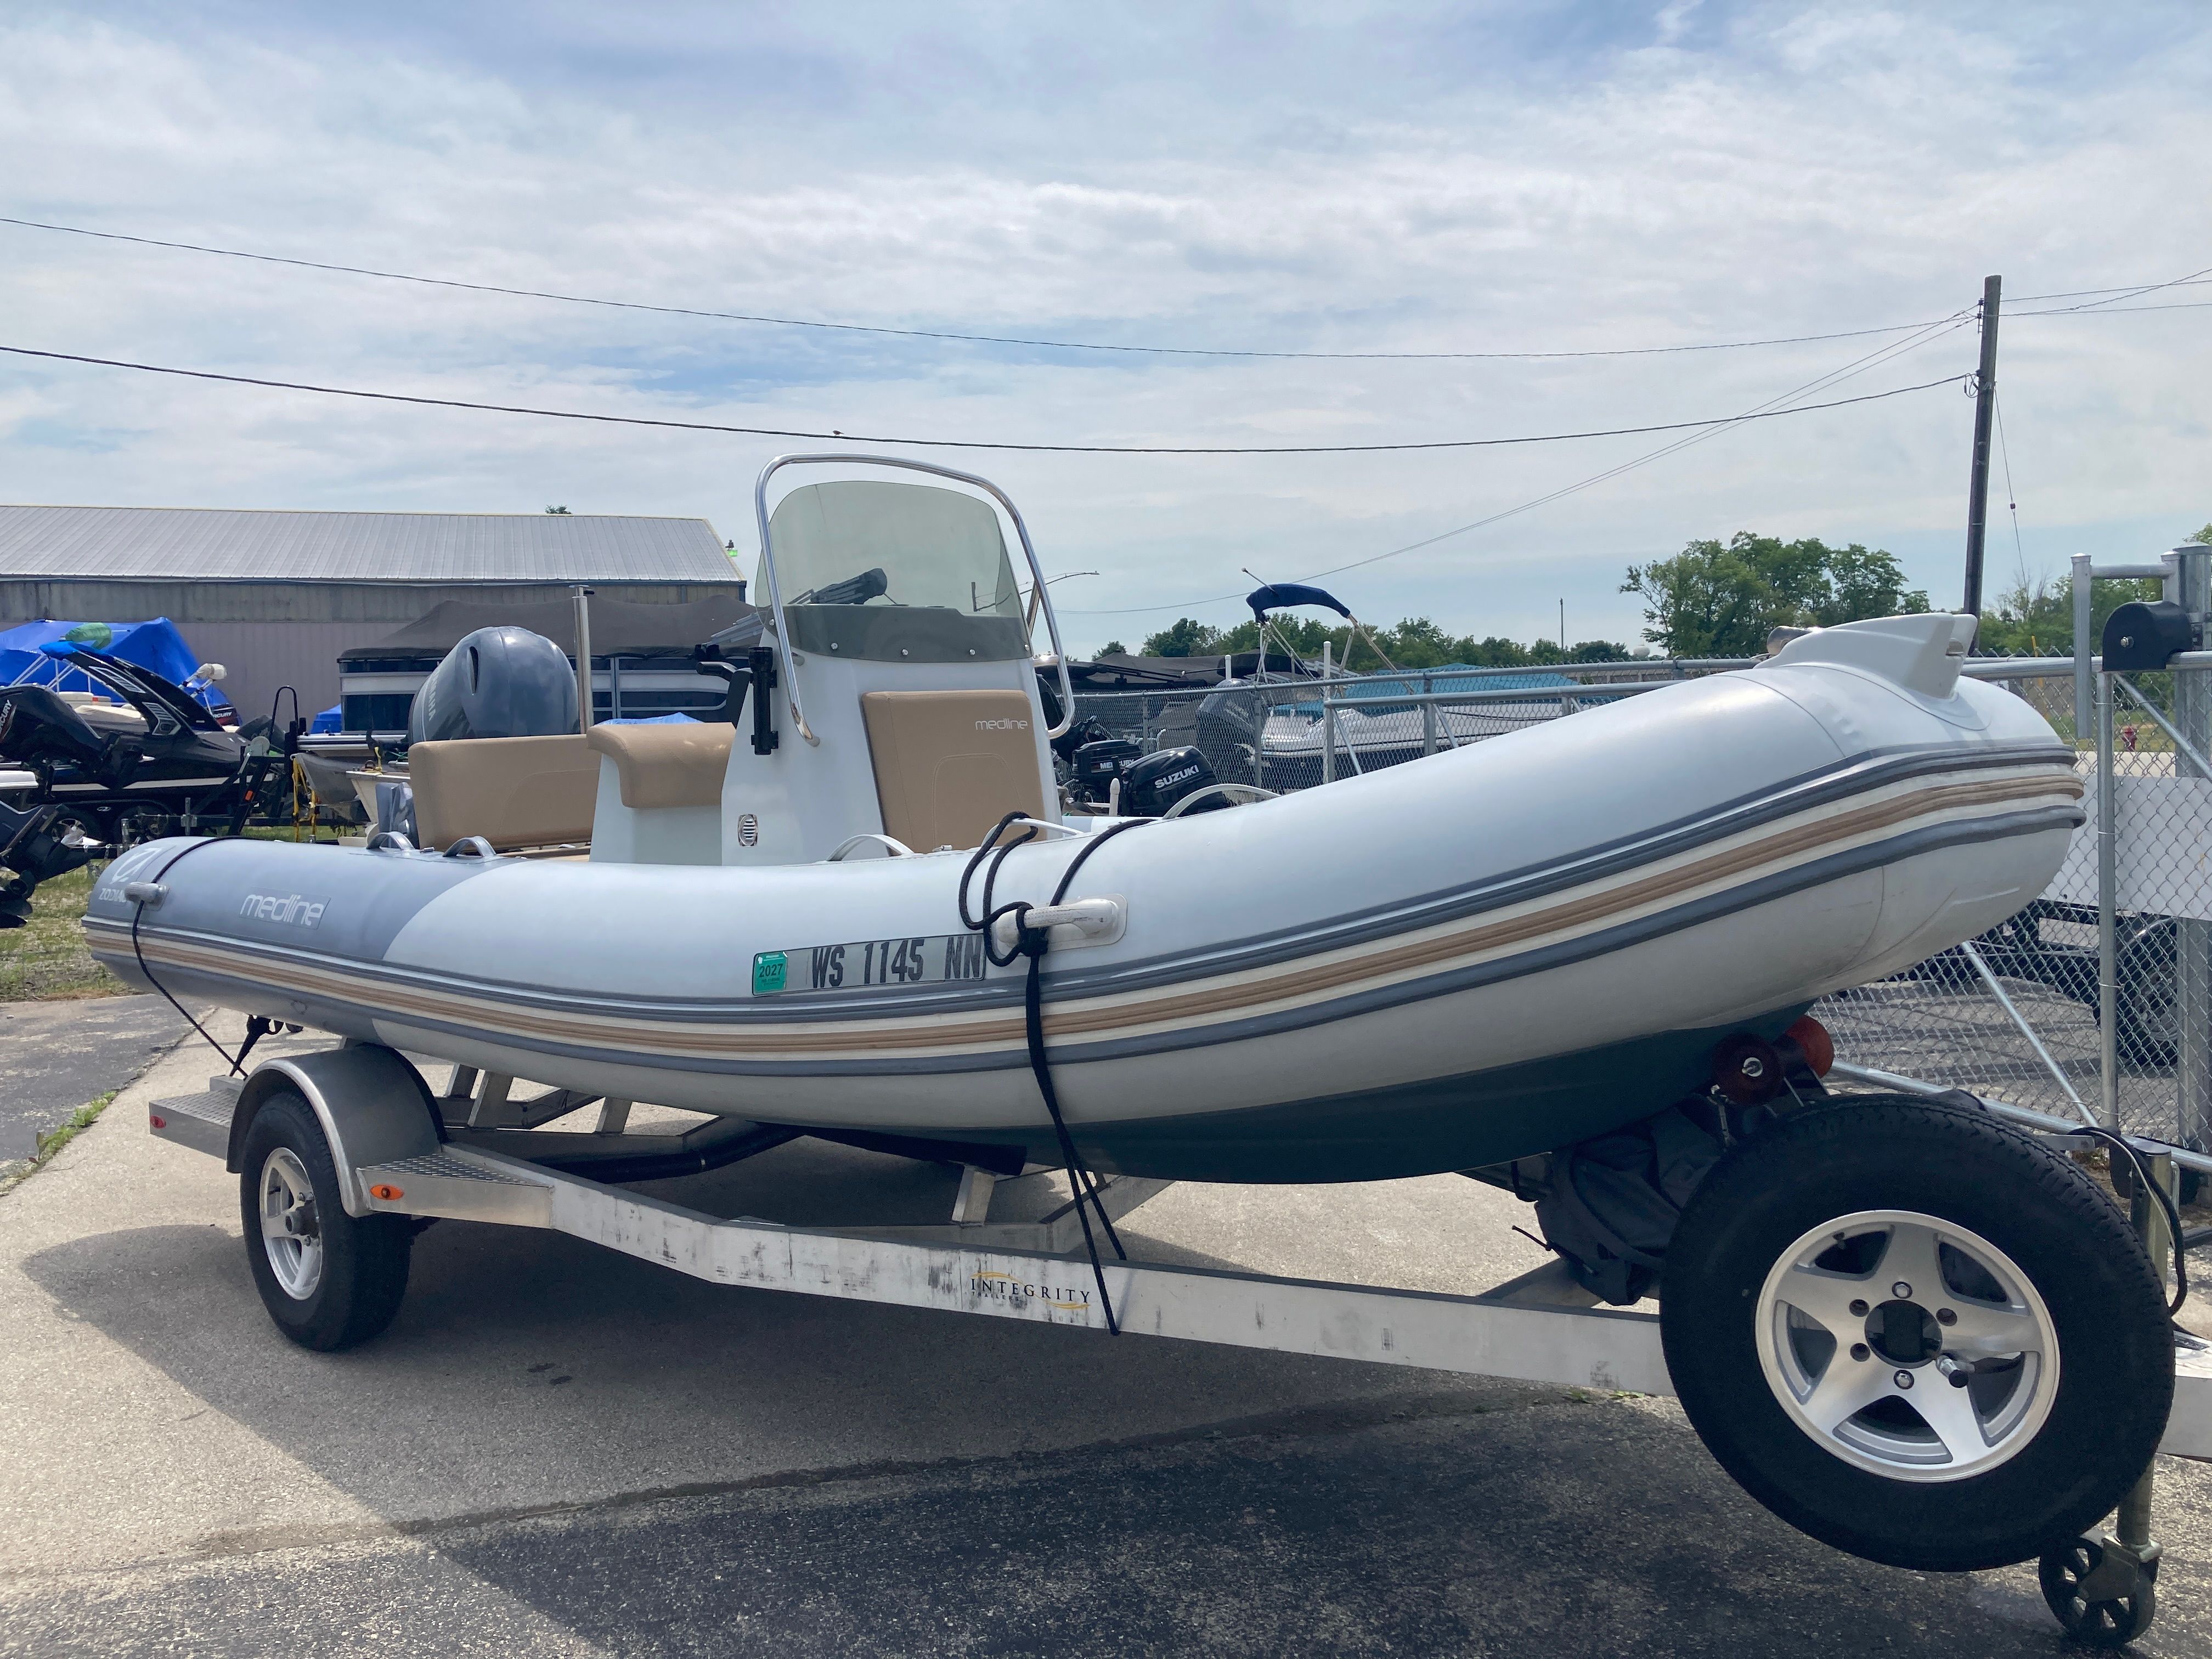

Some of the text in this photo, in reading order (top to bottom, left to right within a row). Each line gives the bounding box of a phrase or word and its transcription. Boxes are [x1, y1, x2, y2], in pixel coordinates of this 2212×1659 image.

[0, 699, 12, 735] CURY
[975, 718, 1028, 730] medline
[1100, 759, 1135, 769] MEURY
[1154, 764, 1200, 789] SUZUKI
[98, 888, 127, 903] ZODIA
[240, 894, 325, 926] medline
[759, 963, 783, 978] 2027
[812, 934, 983, 989] WS 1145 NN
[971, 1278, 1090, 1304] INTEGRITY
[972, 1291, 1019, 1302] TRAILERS
